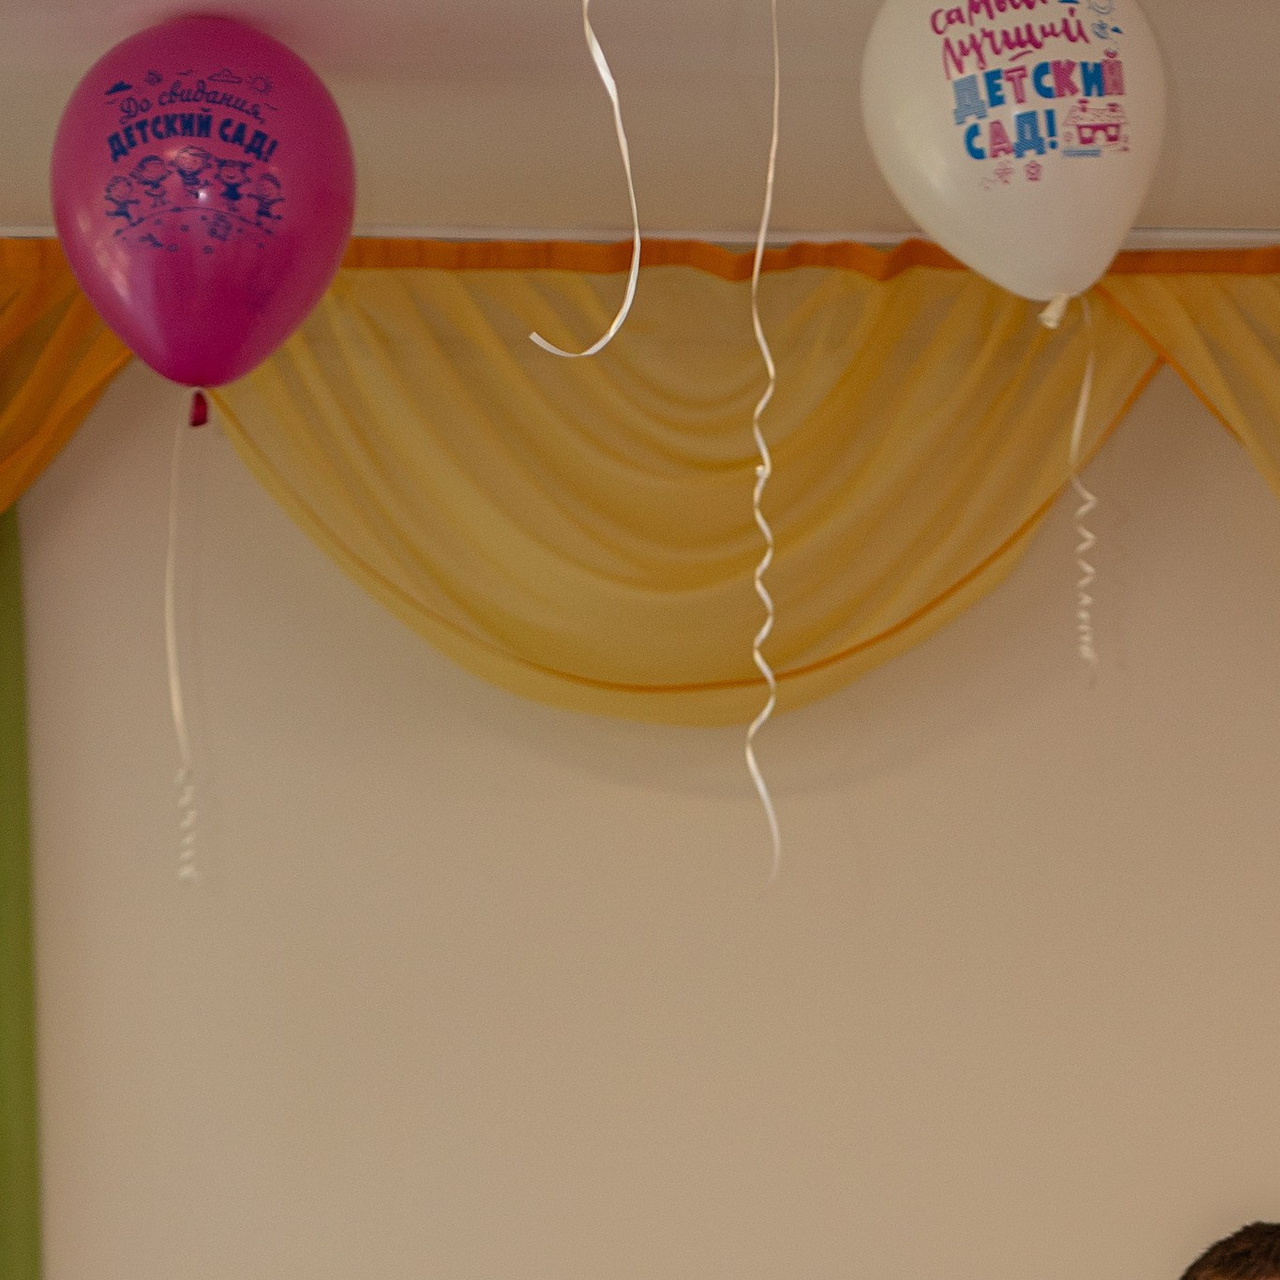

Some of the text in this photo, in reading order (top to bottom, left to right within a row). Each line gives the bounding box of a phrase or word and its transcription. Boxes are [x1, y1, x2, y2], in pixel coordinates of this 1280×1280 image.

[942, 7, 1090, 81] лучший
[953, 49, 1125, 124] ДЕТСКИЙ
[107, 107, 278, 162] ДЕТСКИЙ САД!
[964, 109, 1058, 160] САД!
